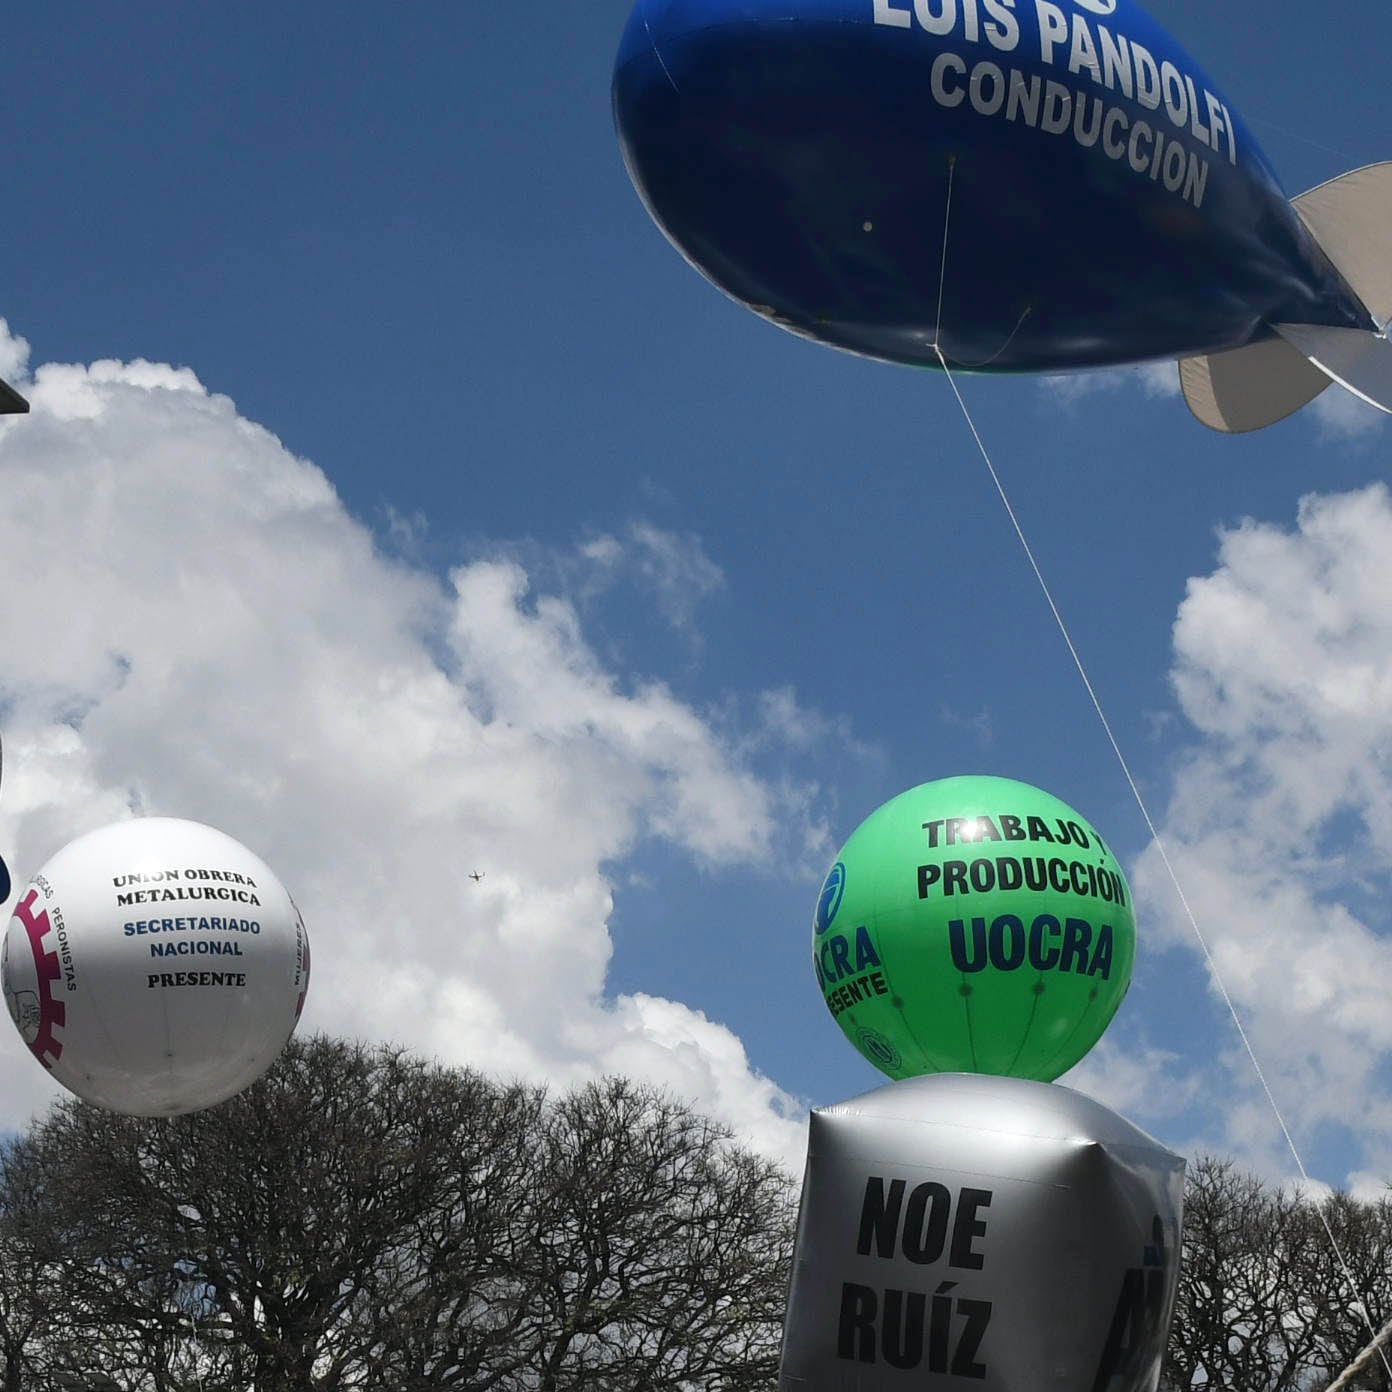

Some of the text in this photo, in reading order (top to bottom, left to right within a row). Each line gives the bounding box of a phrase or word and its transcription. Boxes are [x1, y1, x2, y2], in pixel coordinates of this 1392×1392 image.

[1038, 0, 1238, 165] PANDOLFI
[930, 53, 1209, 208] CONDUCCION
[922, 814, 1108, 857] TRABAJO Y
[116, 886, 262, 908] METALURGICA
[184, 868, 258, 889] OBRERA
[917, 856, 1126, 907] PRODUCCIÓN
[51, 907, 77, 992] PERONISTAS
[123, 917, 261, 936] SECRETARIADO
[150, 941, 243, 957] NACIONAL
[948, 914, 1115, 981] UOCRA
[148, 972, 246, 989] PRESENTE
[857, 1176, 993, 1270] NOE
[837, 1281, 992, 1379] RUÍZ
